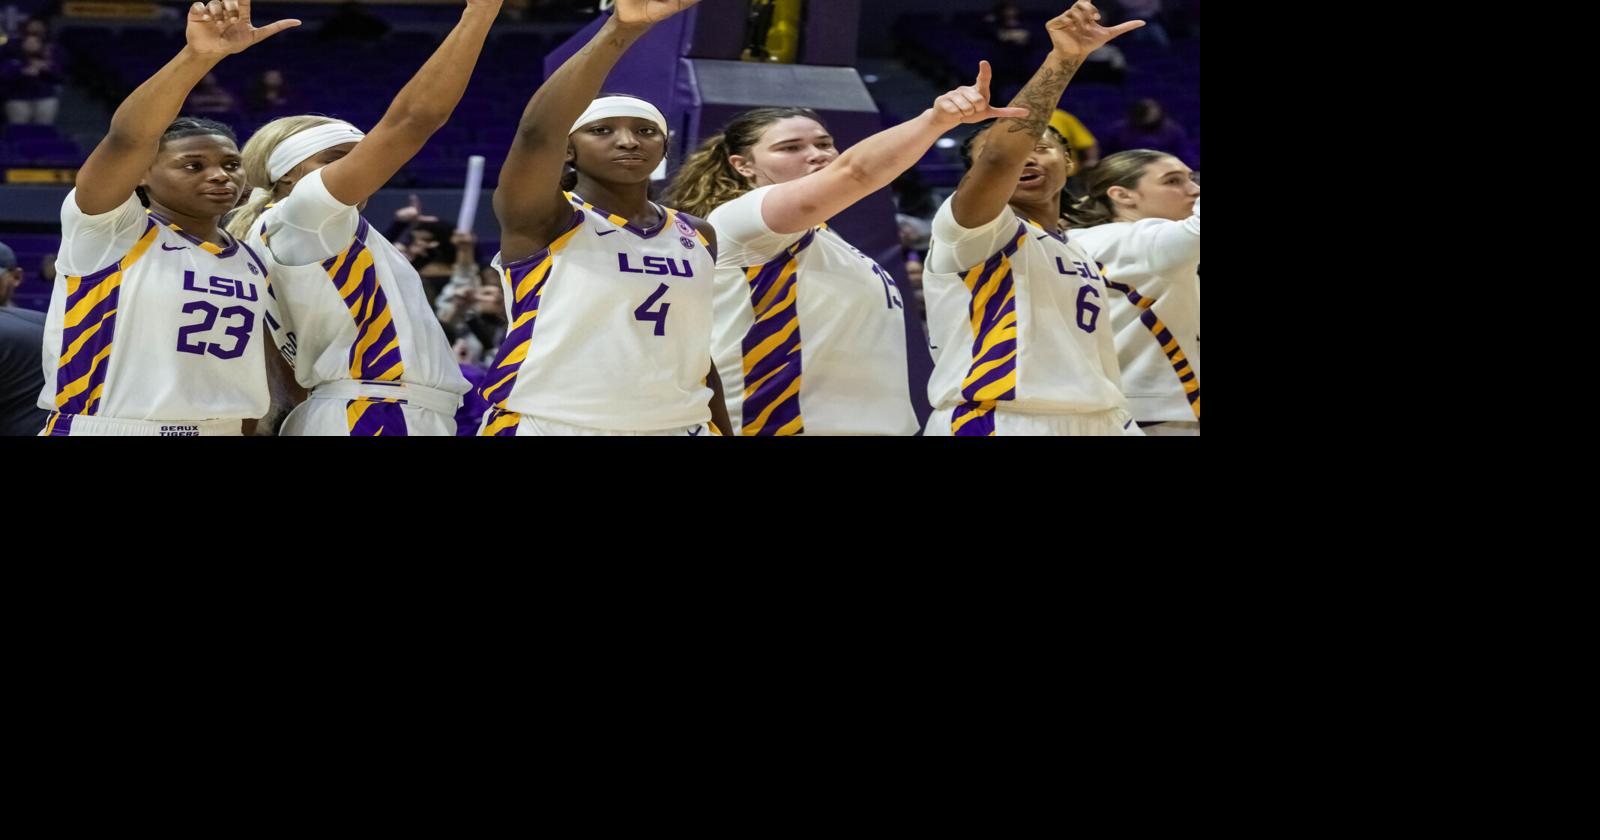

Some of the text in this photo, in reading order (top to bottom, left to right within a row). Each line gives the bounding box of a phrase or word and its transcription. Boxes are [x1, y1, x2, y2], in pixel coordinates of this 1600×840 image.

[183, 270, 259, 302] LSU
[618, 252, 694, 278] LSU
[176, 300, 256, 360] 23
[634, 282, 671, 336] 4
[1076, 284, 1101, 334] 6
